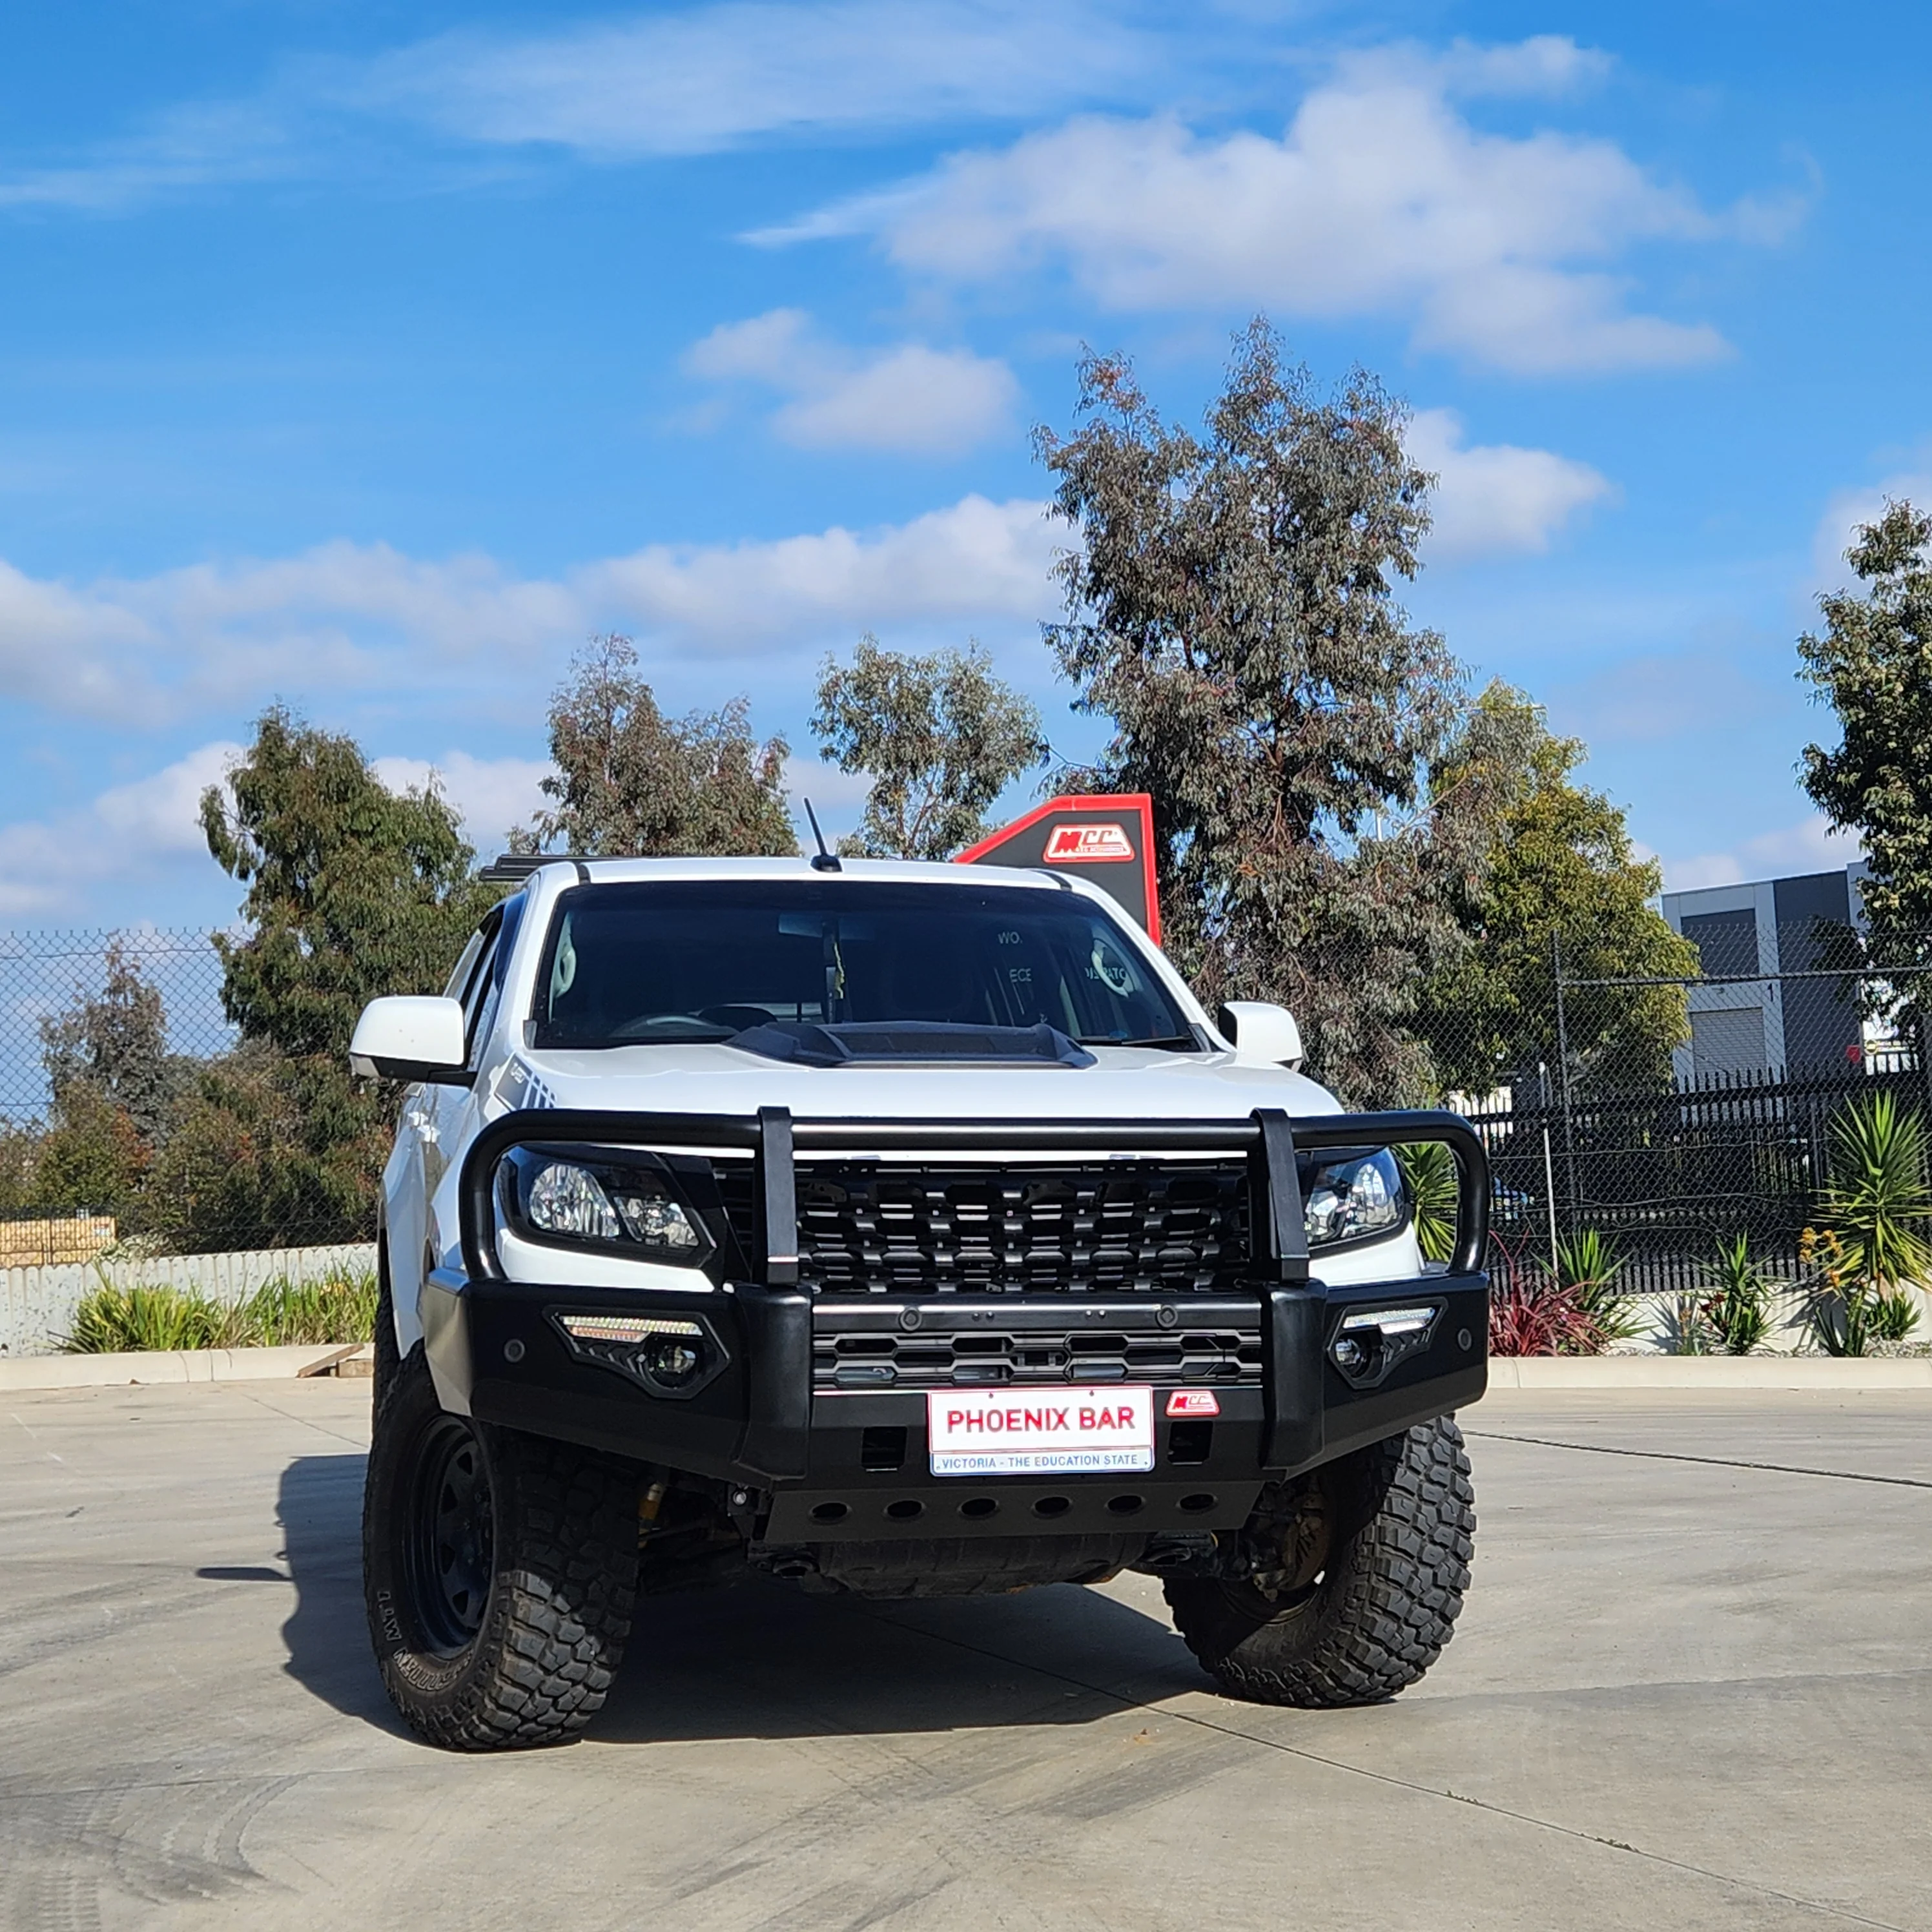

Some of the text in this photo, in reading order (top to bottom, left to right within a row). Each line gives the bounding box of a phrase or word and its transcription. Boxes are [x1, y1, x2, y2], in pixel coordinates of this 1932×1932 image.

[947, 1406, 1135, 1434] PHOENIX BAR
[942, 1457, 996, 1469] VICTORIA
[1009, 1457, 1031, 1468] THE
[1034, 1455, 1100, 1468] EDUCATION
[1104, 1454, 1138, 1466] STATE
